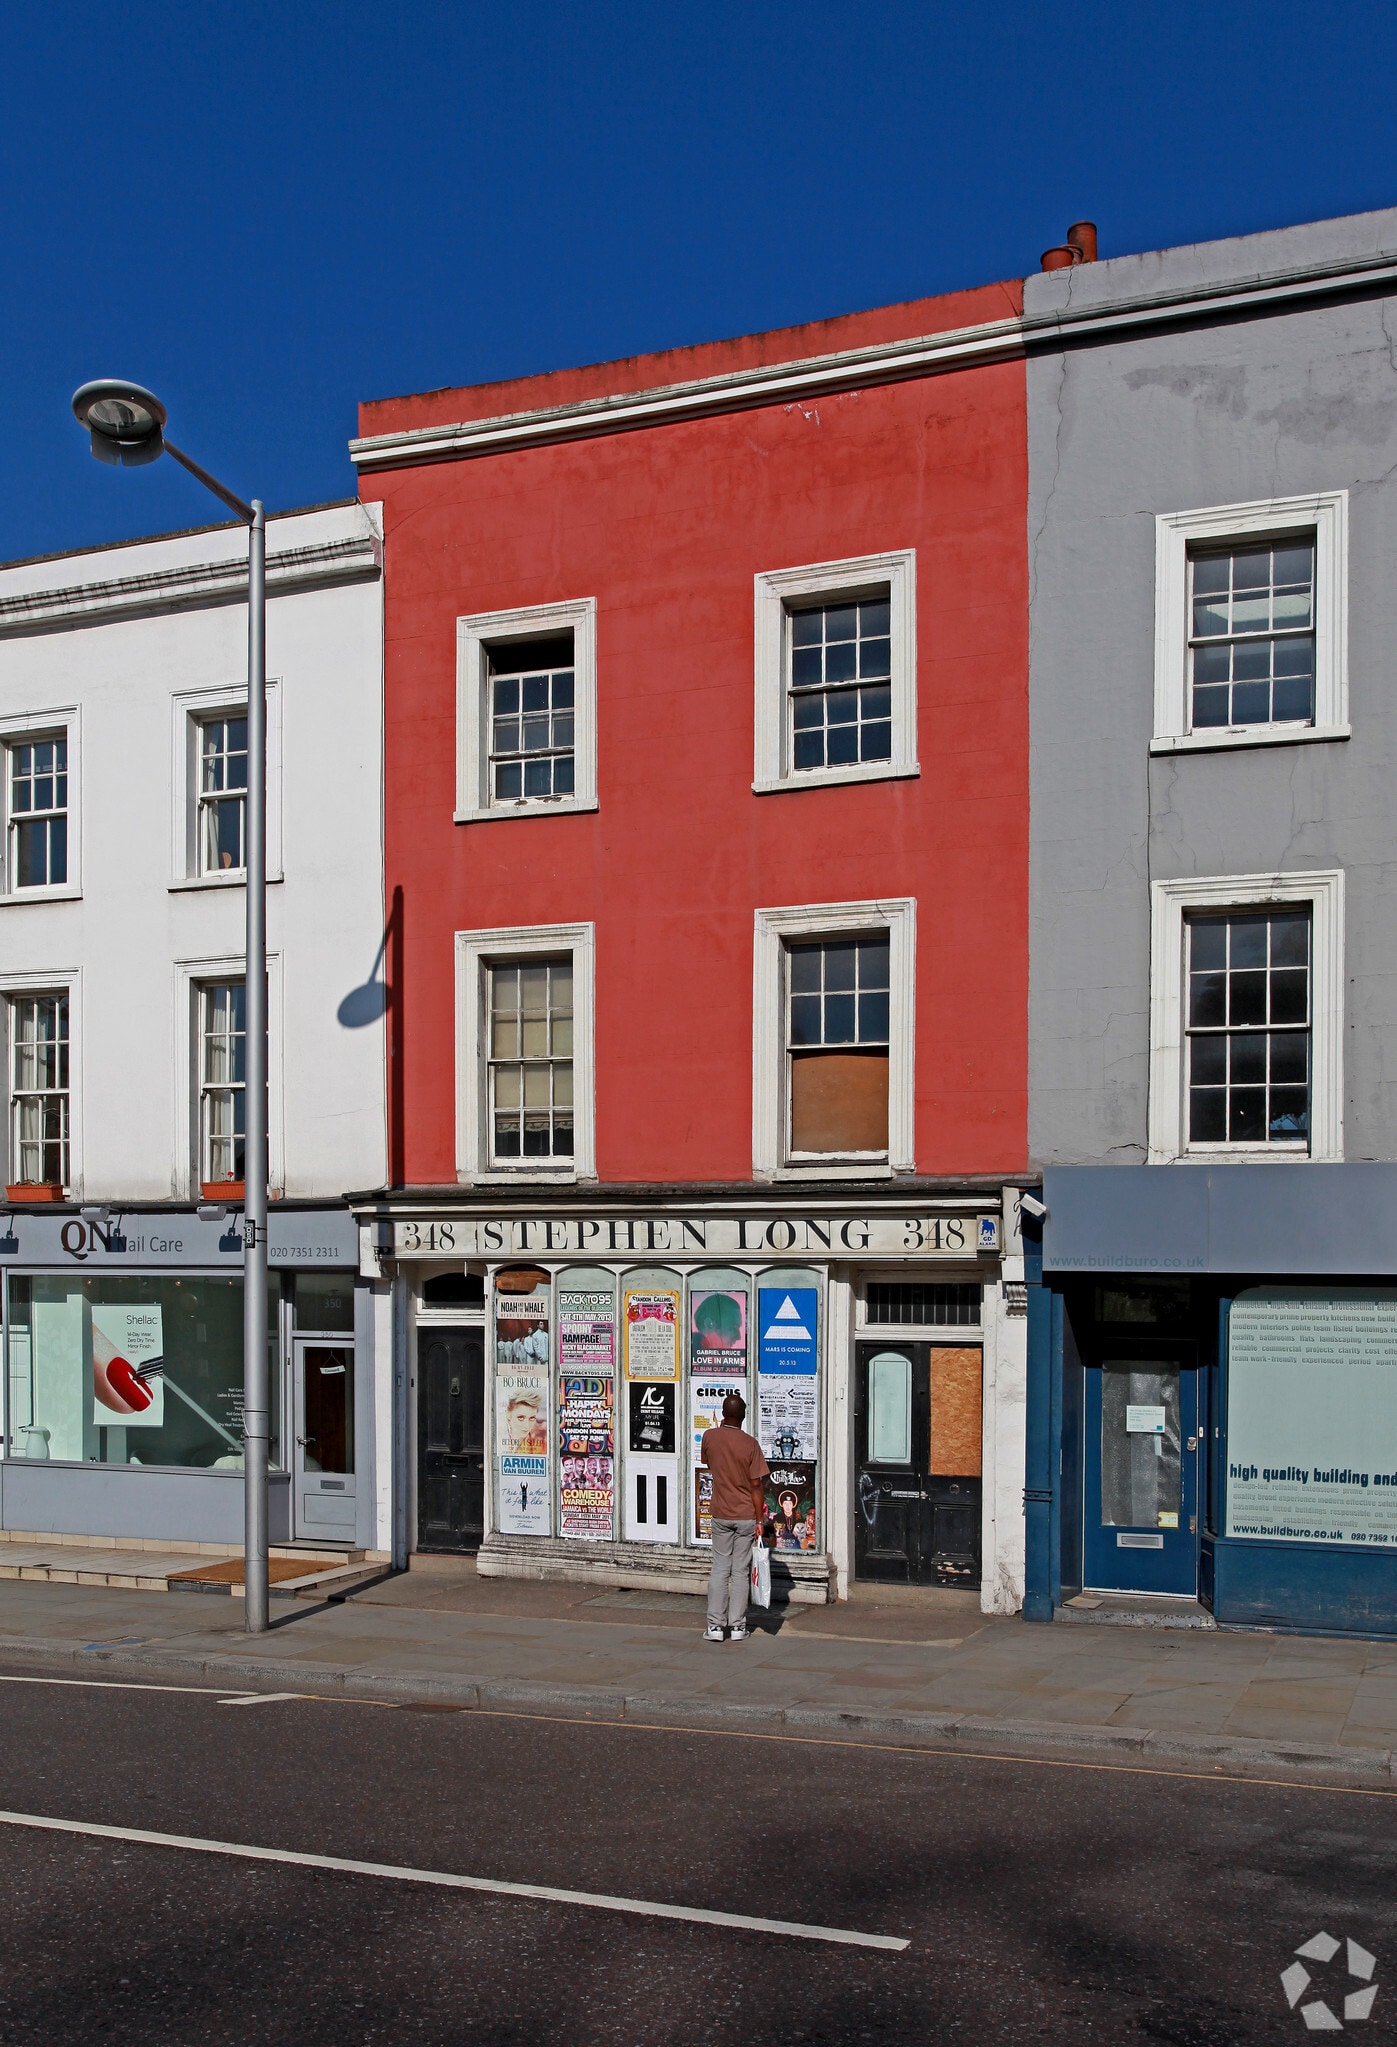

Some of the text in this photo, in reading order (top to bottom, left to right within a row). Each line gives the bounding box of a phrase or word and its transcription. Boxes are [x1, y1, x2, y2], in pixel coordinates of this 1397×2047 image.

[404, 1218, 965, 1251] 348 STEPHEN LONG 348
[60, 1219, 114, 1261] QN
[150, 1237, 183, 1252] Care
[270, 1247, 340, 1258] 020 7351 2311
[1050, 1255, 1204, 1268] www.buildburo.co.uk
[324, 1298, 342, 1308] 350
[560, 1294, 611, 1304] BACK TO 95
[500, 1302, 544, 1312] NOAH WHALE
[126, 1314, 158, 1325] Shellac
[562, 1324, 592, 1334] SPOONY
[562, 1334, 600, 1344] RAMPAGE
[1320, 1336, 1362, 1344] landscaping
[723, 1357, 745, 1365] ARMS
[516, 1376, 542, 1388] BRUCE
[696, 1388, 740, 1397] CIRCUS
[570, 1400, 602, 1409] HAPPY
[562, 1410, 610, 1418] MONDAYS
[504, 1458, 544, 1469] ARMIN
[1230, 1463, 1258, 1482] high
[1263, 1466, 1309, 1484] quality
[1314, 1468, 1368, 1488] building
[502, 1488, 518, 1496] This
[529, 1488, 548, 1496] what
[563, 1490, 610, 1500] COMEDY
[530, 1496, 544, 1504] like
[1233, 1524, 1388, 1542] www.buildburo.co.uk 020 7352
